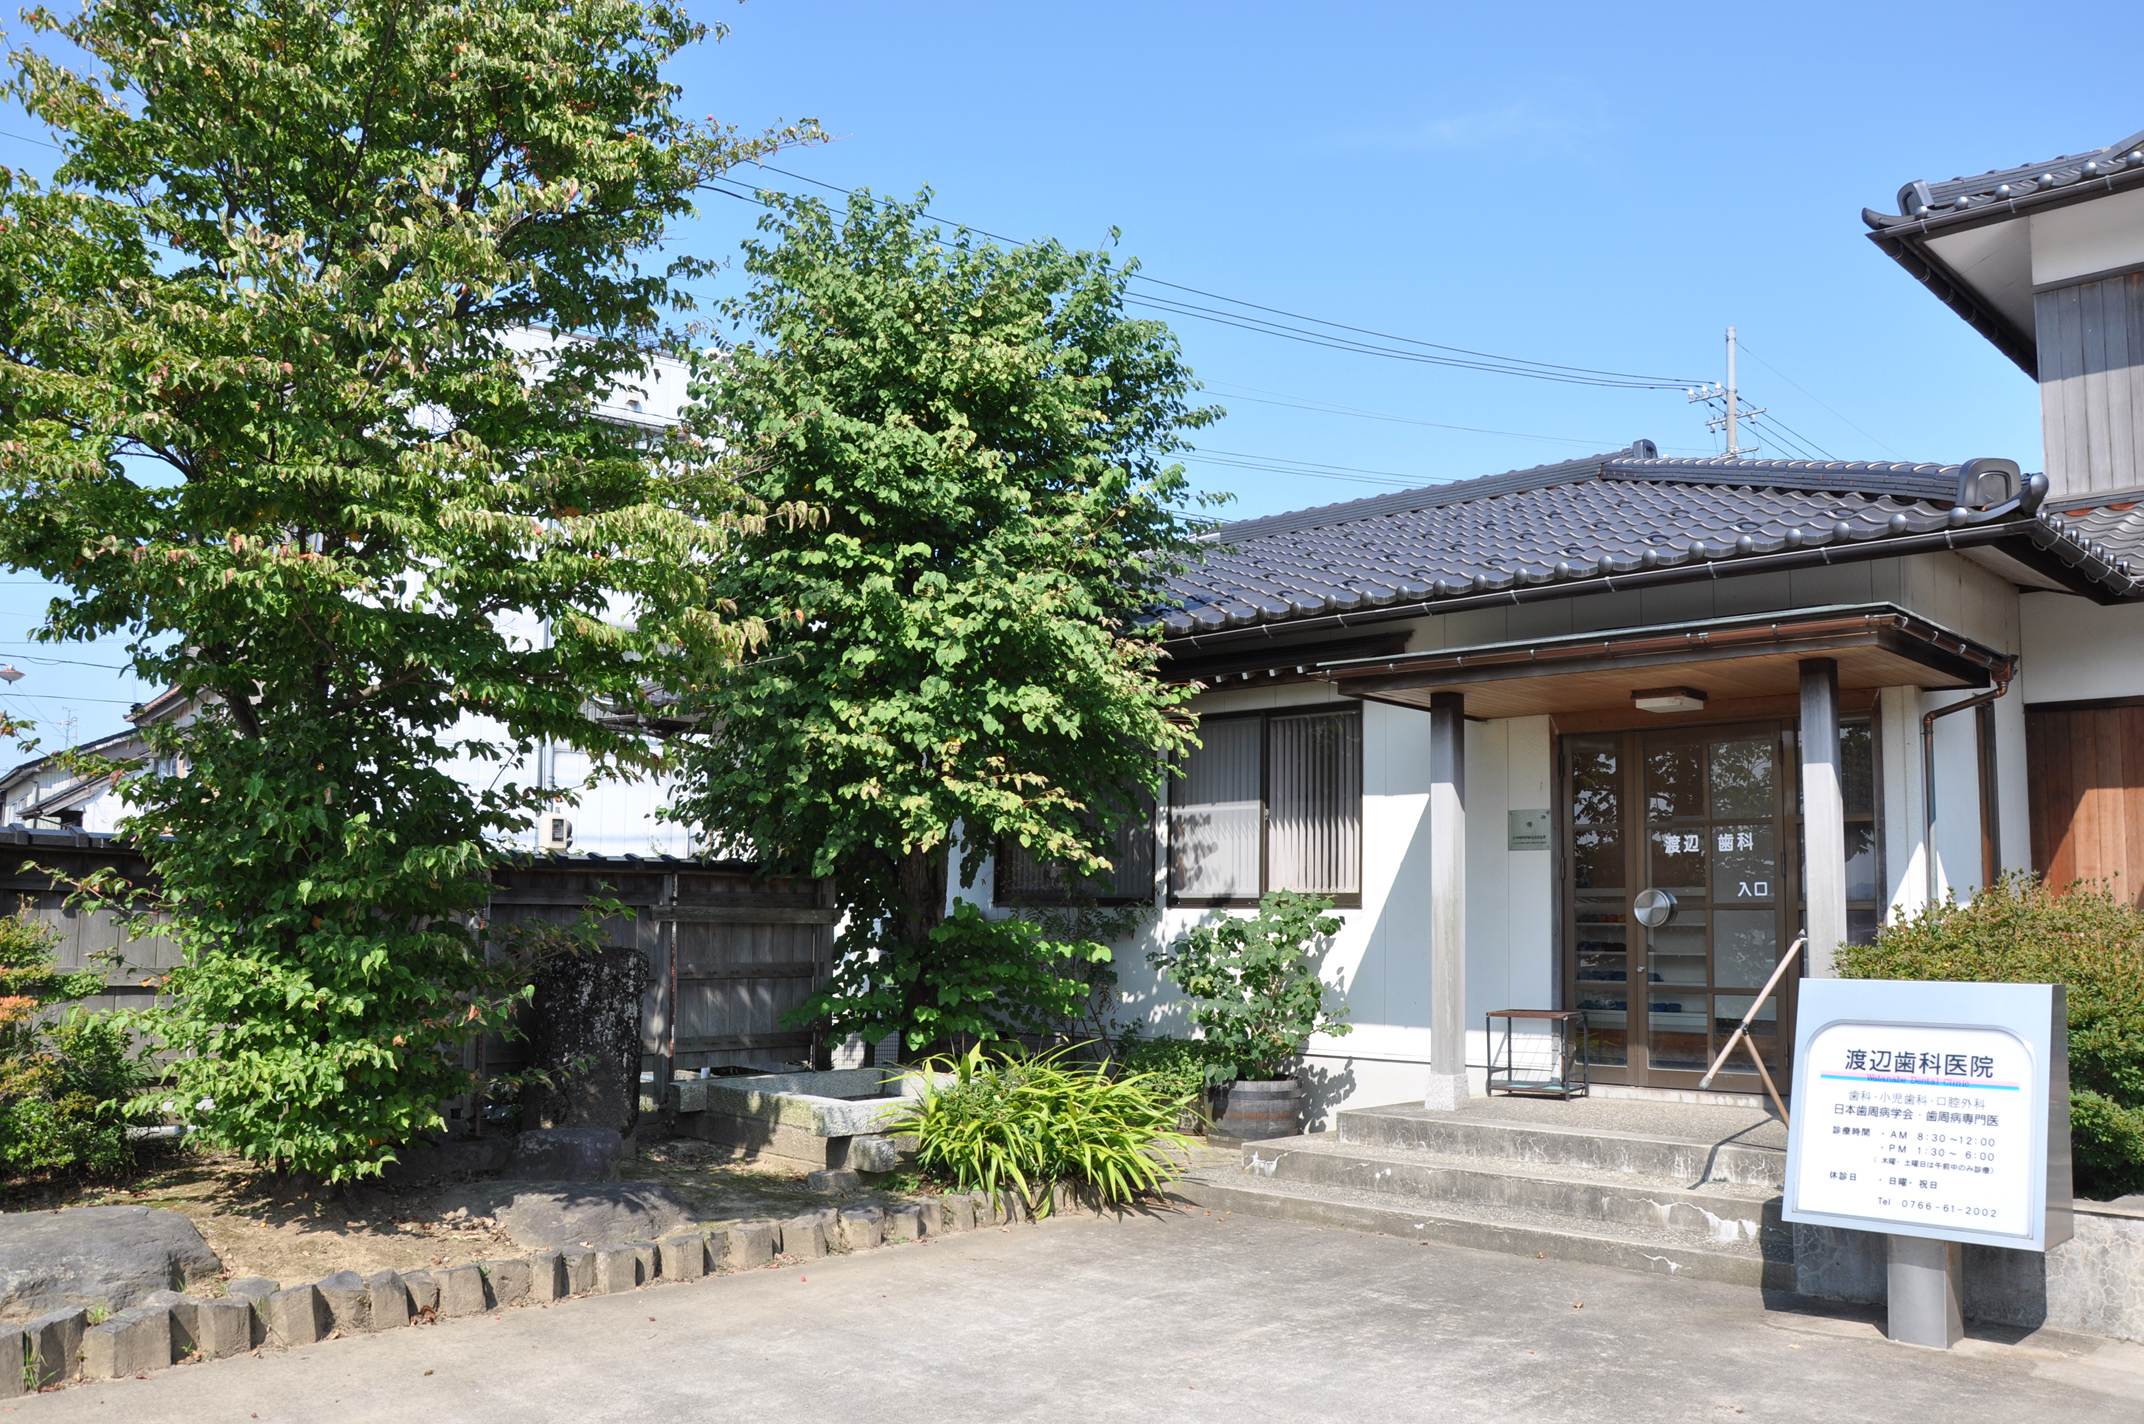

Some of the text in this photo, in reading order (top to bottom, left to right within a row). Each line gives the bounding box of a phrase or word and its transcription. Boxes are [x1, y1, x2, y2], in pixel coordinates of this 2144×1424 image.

[1737, 881, 1768, 897] 入口
[1845, 1049, 1994, 1078] 渡辺歯科医院
